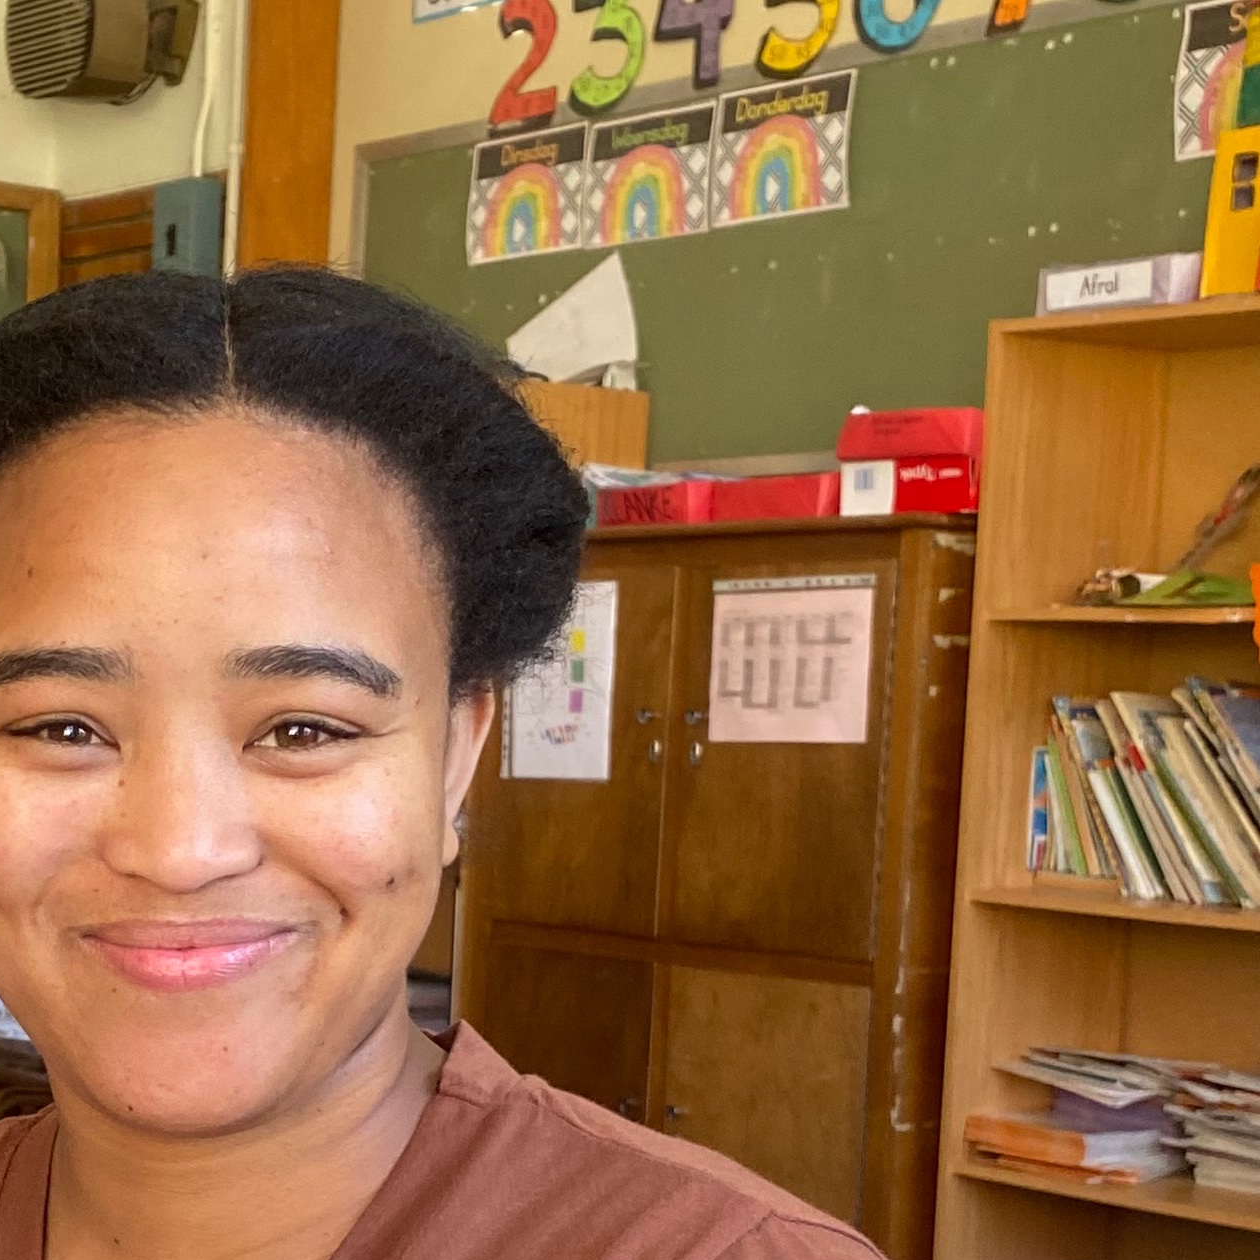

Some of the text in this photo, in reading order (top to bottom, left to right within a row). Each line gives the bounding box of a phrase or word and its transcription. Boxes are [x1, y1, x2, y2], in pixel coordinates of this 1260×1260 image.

[488, 0, 558, 132] 2
[735, 84, 830, 123] Donderdag
[501, 138, 560, 167] Dinsdag
